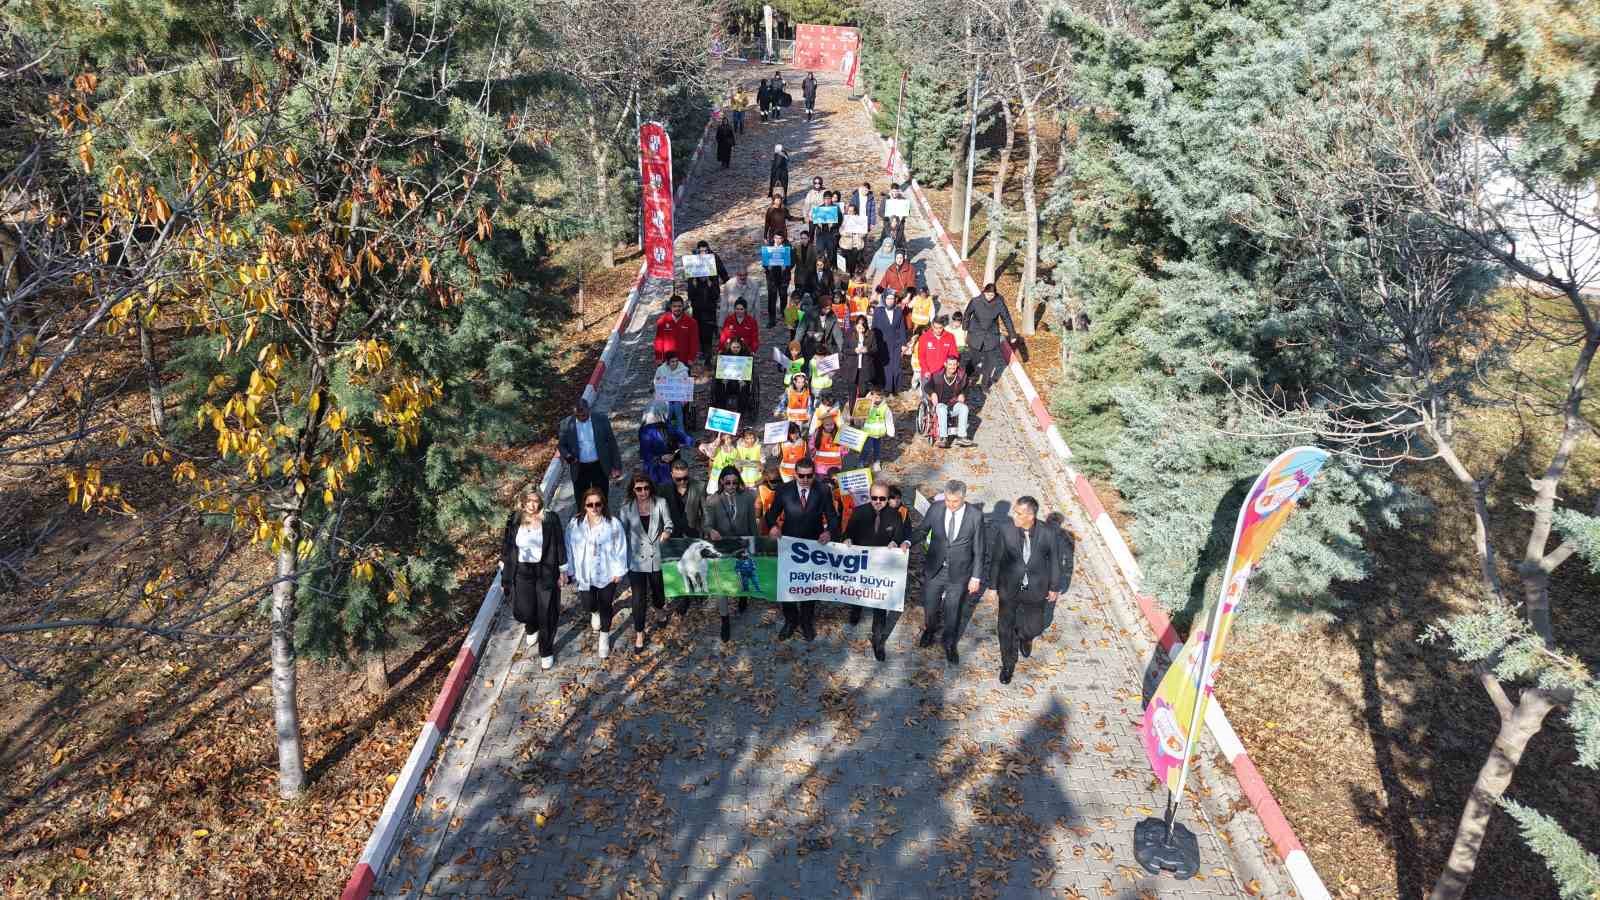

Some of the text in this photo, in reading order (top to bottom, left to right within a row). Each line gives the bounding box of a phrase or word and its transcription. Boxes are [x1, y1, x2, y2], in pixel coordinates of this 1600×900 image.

[790, 542, 869, 574] Sevgi
[790, 571, 896, 588] paylaştıkça büyür
[789, 584, 887, 601] engeller küçülür
